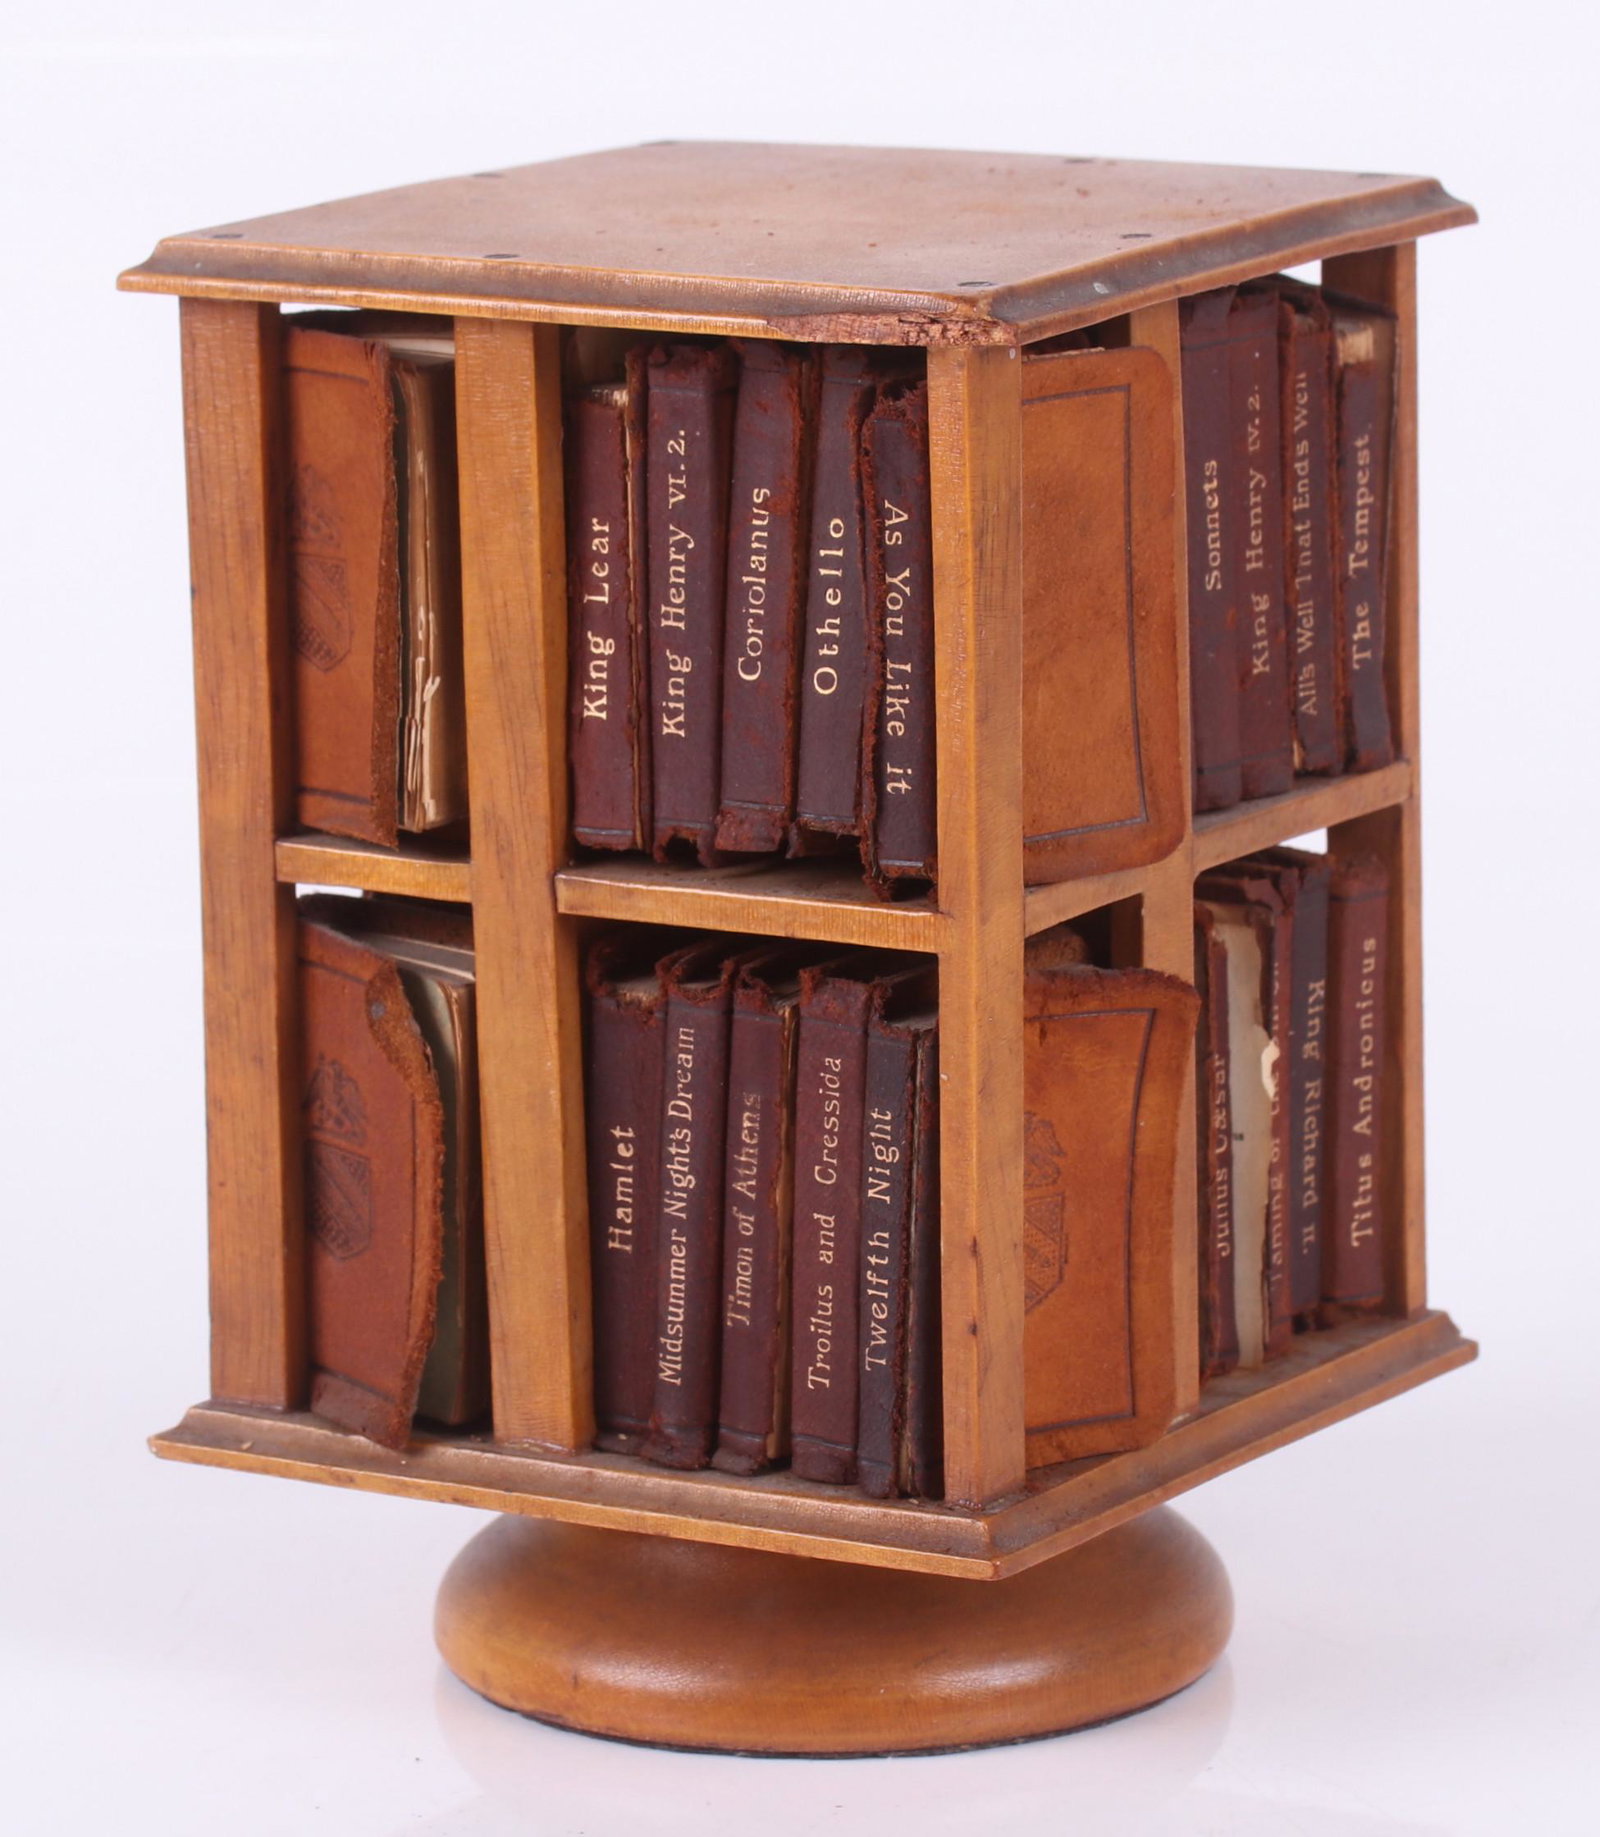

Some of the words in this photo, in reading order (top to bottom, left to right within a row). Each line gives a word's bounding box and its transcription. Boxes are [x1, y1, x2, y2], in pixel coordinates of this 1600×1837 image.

[1246, 469, 1267, 571] Henry
[1293, 439, 1310, 512] Ends
[1349, 434, 1374, 579] Tempest
[584, 517, 610, 605] Lear
[884, 500, 909, 546] As
[1203, 459, 1222, 591] Sonnets
[661, 523, 695, 630] Henry
[738, 487, 770, 681] Coriolanus
[814, 517, 844, 695] Othello
[885, 568, 910, 636] You
[1253, 593, 1270, 675] King
[1297, 600, 1314, 653] Well
[1352, 601, 1372, 669] The
[584, 631, 615, 721] King
[662, 649, 692, 738] King
[886, 662, 911, 737] Like
[886, 762, 912, 794] it
[1302, 979, 1325, 1060] King
[1353, 937, 1377, 1136] Andronicus
[668, 1027, 694, 1121] Dream
[814, 1056, 842, 1184] Cressida
[608, 1125, 636, 1255] Hamlet
[664, 1127, 695, 1219] Night's
[732, 1093, 761, 1200] Athens
[867, 1108, 899, 1204] Night
[1302, 1078, 1322, 1209] Richard
[734, 1207, 756, 1236] of
[813, 1213, 835, 1264] and
[1351, 1154, 1373, 1248] Titus
[658, 1229, 687, 1386] Midsummer
[727, 1246, 753, 1326] Timon
[865, 1231, 890, 1371] Twelfth
[808, 1284, 833, 1390] Troilus
